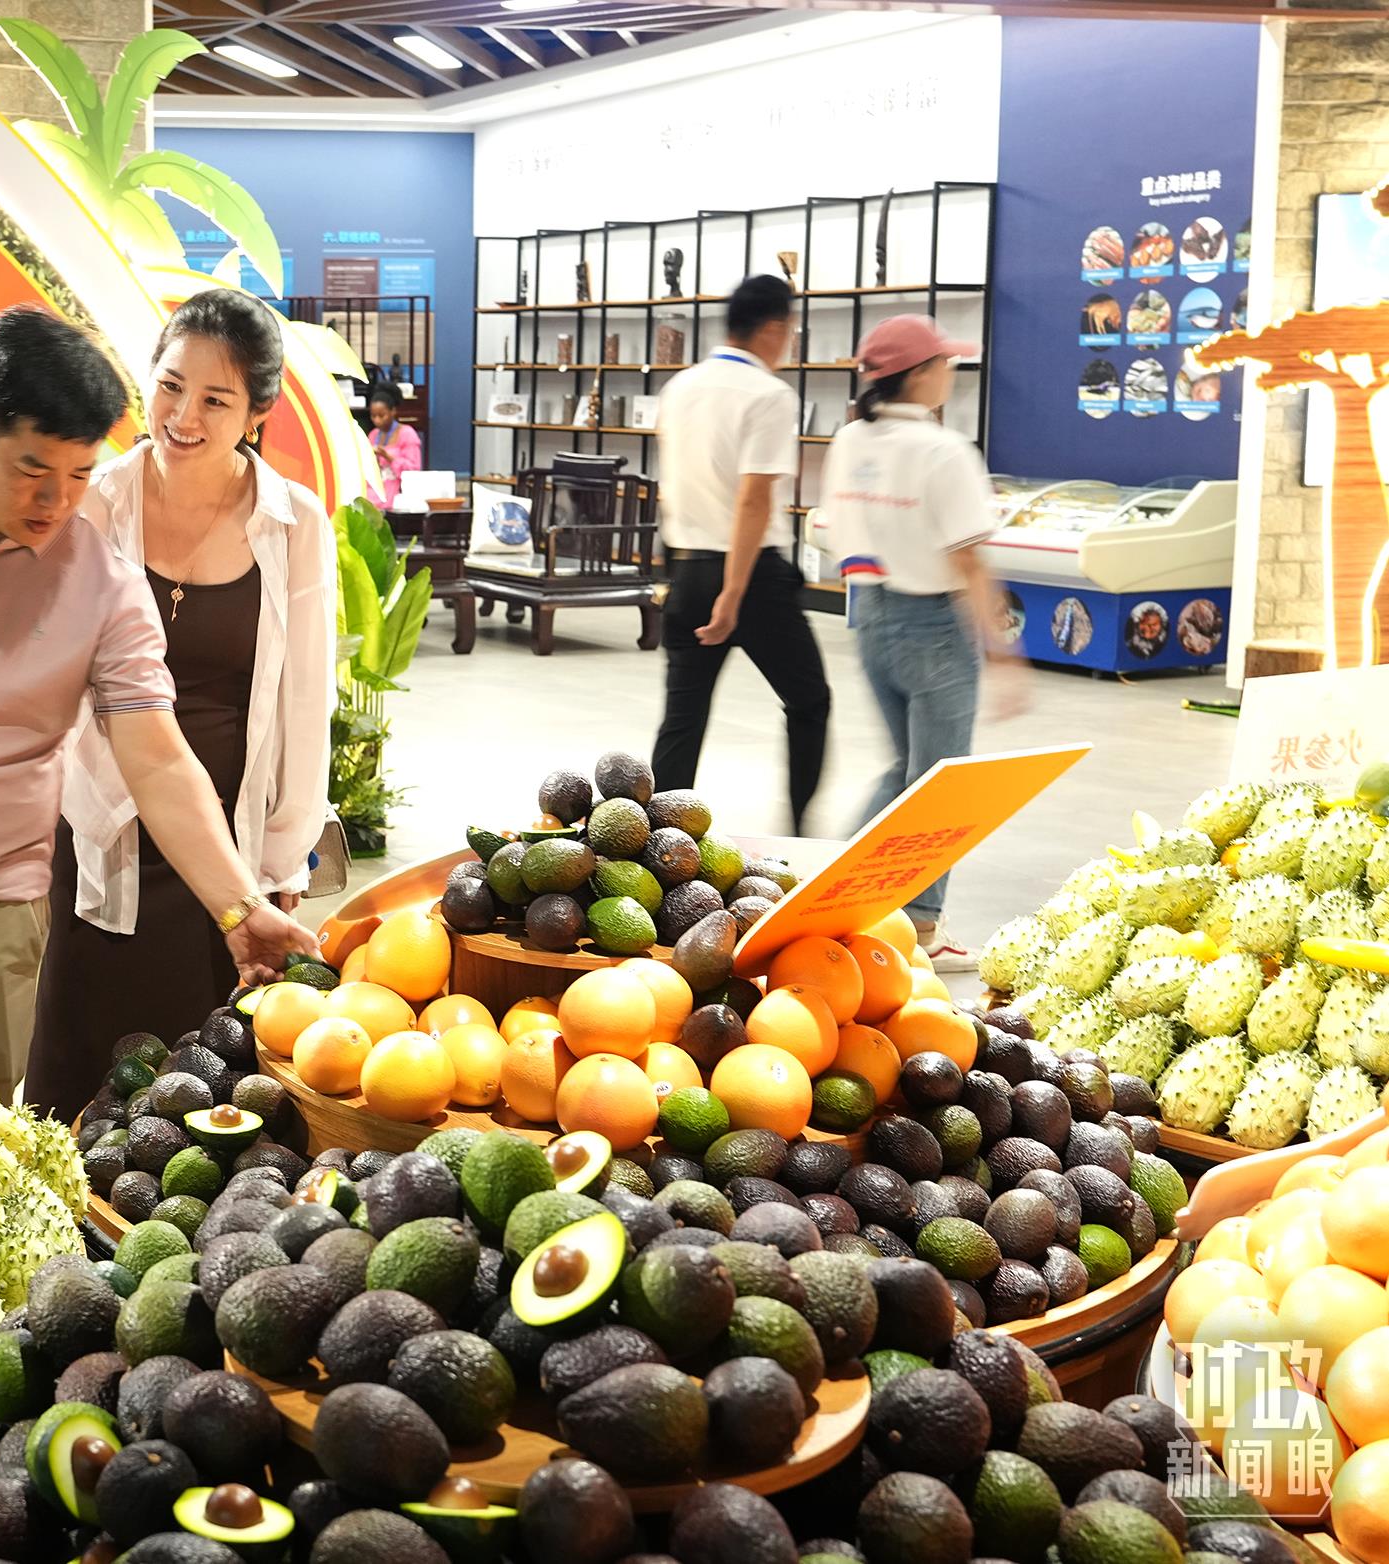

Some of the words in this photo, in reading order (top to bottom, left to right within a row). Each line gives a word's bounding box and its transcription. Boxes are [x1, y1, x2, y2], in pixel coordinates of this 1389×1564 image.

[1140, 170, 1221, 196] 重点海鲜品类
